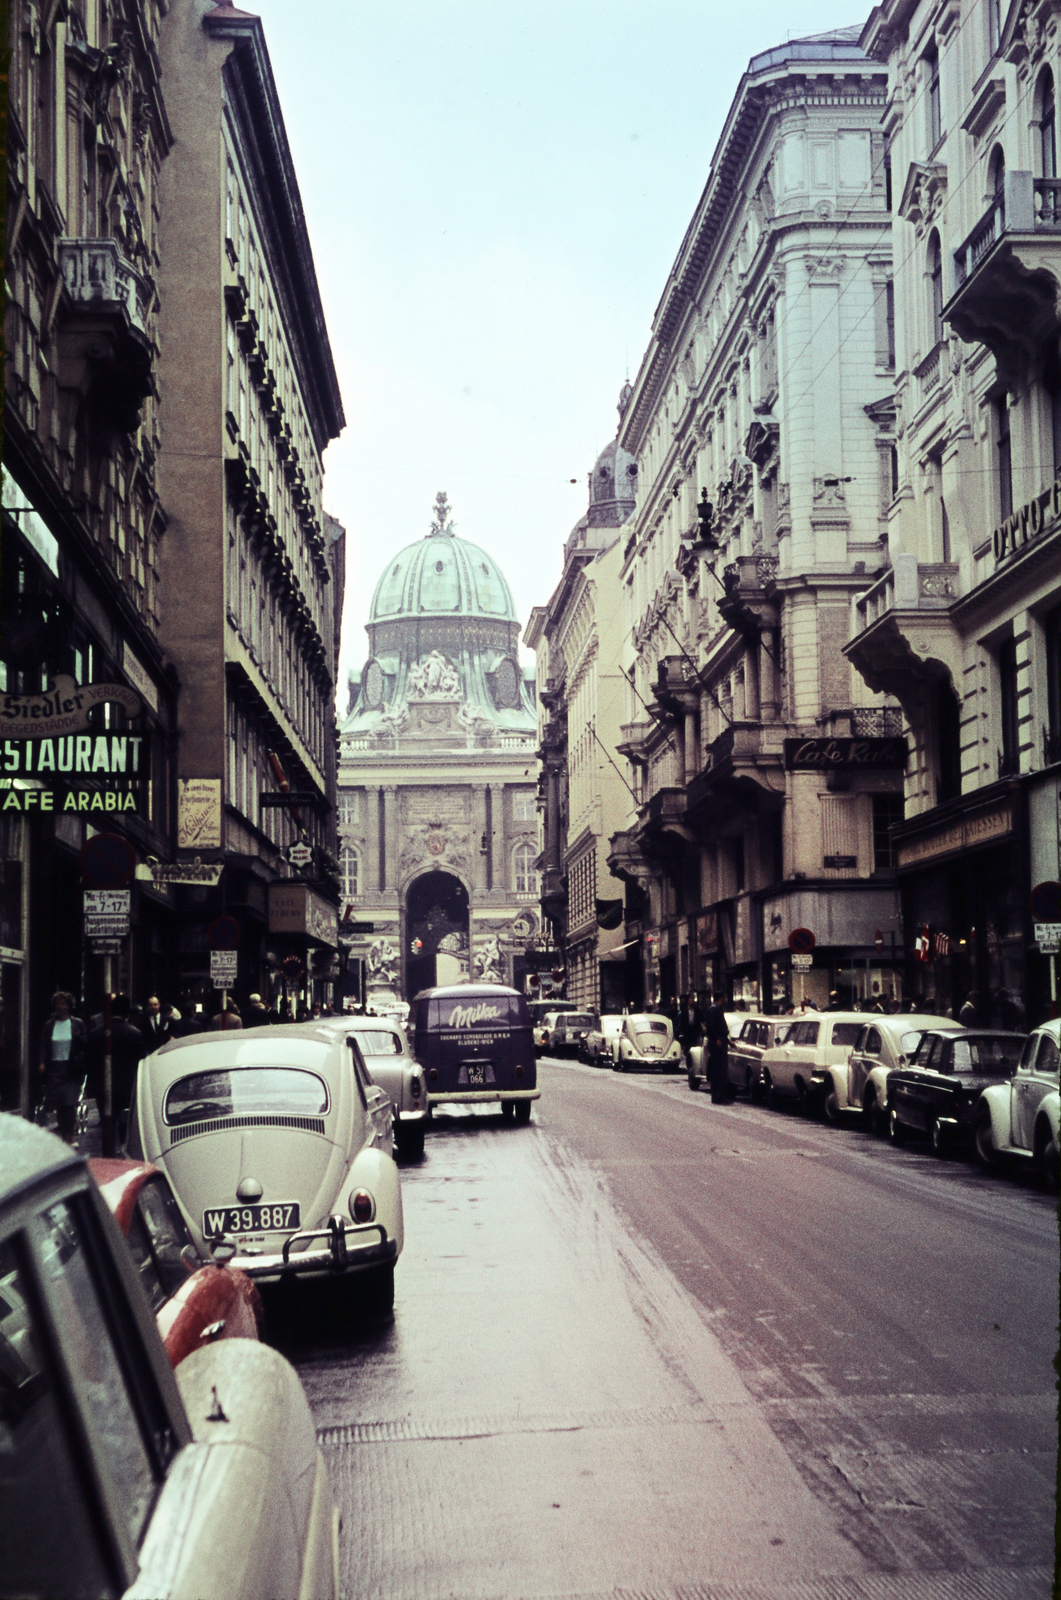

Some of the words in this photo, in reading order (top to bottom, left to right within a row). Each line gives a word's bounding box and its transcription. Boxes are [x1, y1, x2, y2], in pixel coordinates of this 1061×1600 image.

[991, 497, 1045, 562] OTTO
[1, 690, 85, 719] Siedler
[88, 685, 138, 707] VERKAUF
[0, 714, 80, 734] GEGENSTÄNDE
[0, 736, 142, 773] STAURANT
[63, 791, 137, 811] ARABIA
[448, 1002, 501, 1029] Milka
[467, 1066, 475, 1075] W
[208, 1211, 225, 1233] W
[230, 1206, 293, 1231] 39.887
